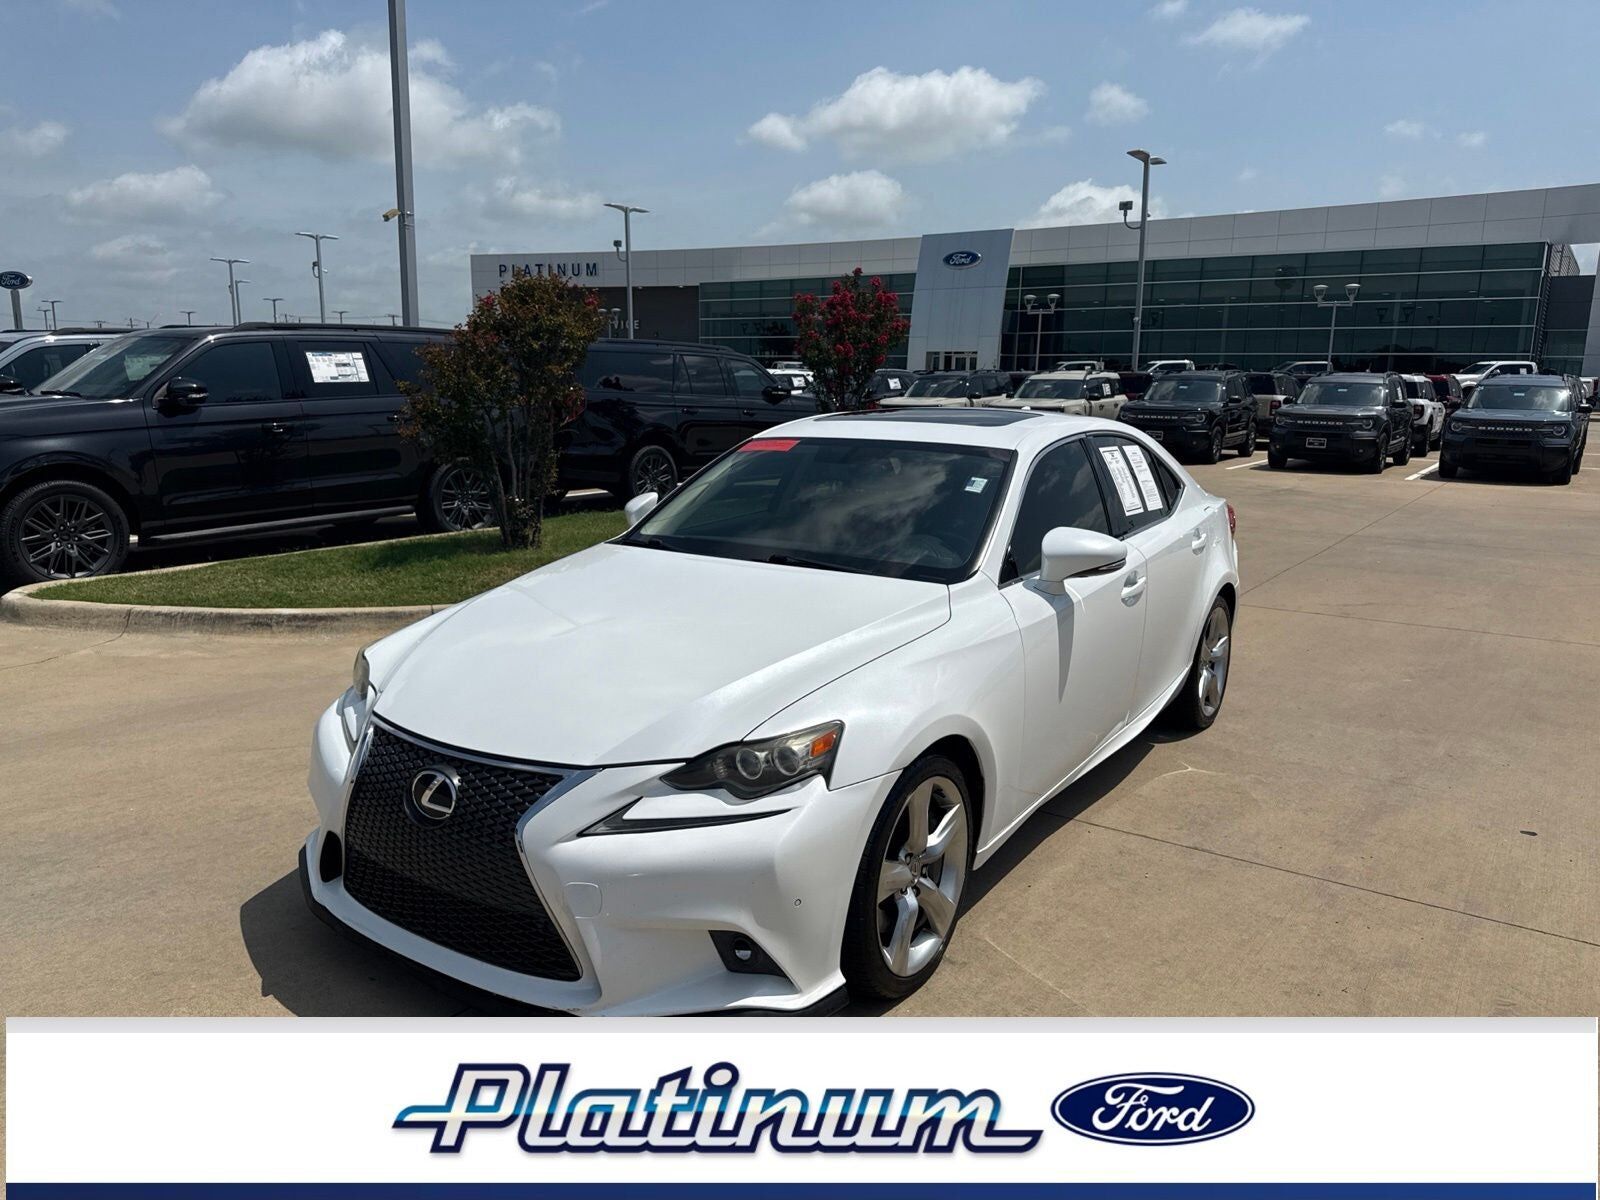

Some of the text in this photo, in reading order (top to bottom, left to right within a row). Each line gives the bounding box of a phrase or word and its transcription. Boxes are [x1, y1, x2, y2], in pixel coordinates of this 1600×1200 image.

[949, 253, 972, 264] Ford
[499, 262, 598, 277] PLATINUM
[1, 274, 21, 285] Ford
